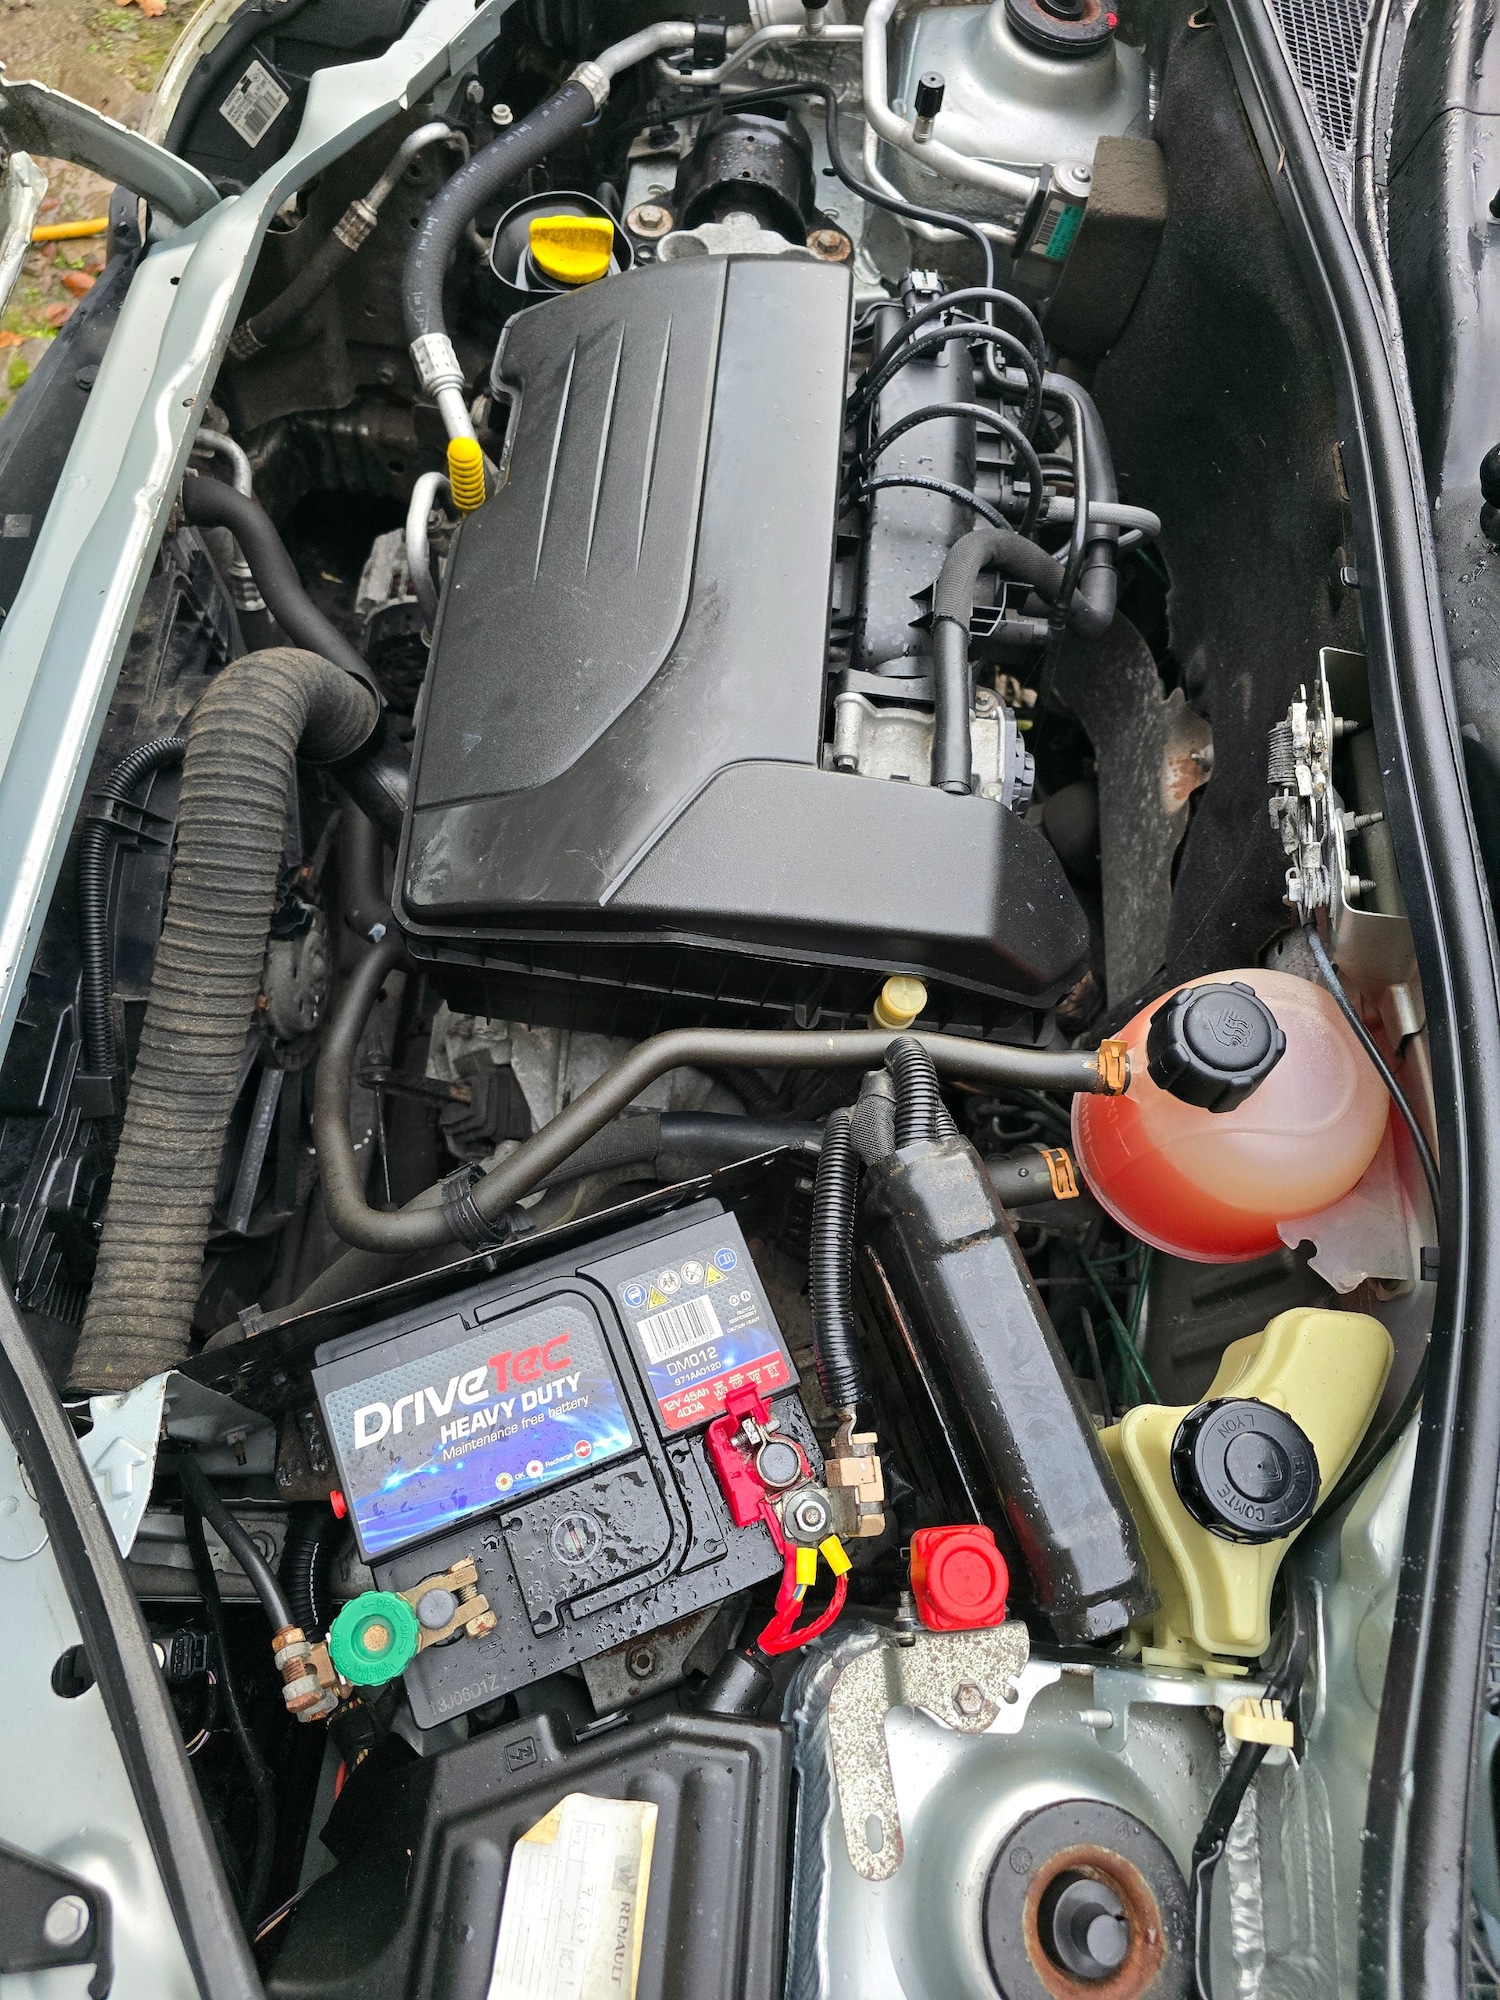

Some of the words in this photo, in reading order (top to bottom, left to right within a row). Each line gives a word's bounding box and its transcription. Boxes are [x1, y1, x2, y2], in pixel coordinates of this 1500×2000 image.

[665, 1346, 719, 1377] DM012
[440, 1396, 516, 1445] HEAVY
[521, 1371, 582, 1413] DUTY
[676, 1401, 705, 1418] 400A
[442, 1424, 519, 1462] Maintenance
[521, 1411, 545, 1431] free
[548, 1394, 589, 1420] battery
[1217, 1413, 1255, 1439] LYON
[514, 1471, 526, 1480] OK
[544, 1452, 574, 1468] Recharge
[1217, 1482, 1266, 1522] COMTE
[376, 1598, 396, 1611] OFF
[400, 1623, 409, 1639] ON
[355, 1671, 373, 1682] AND
[612, 1900, 631, 1987] RENAULT
